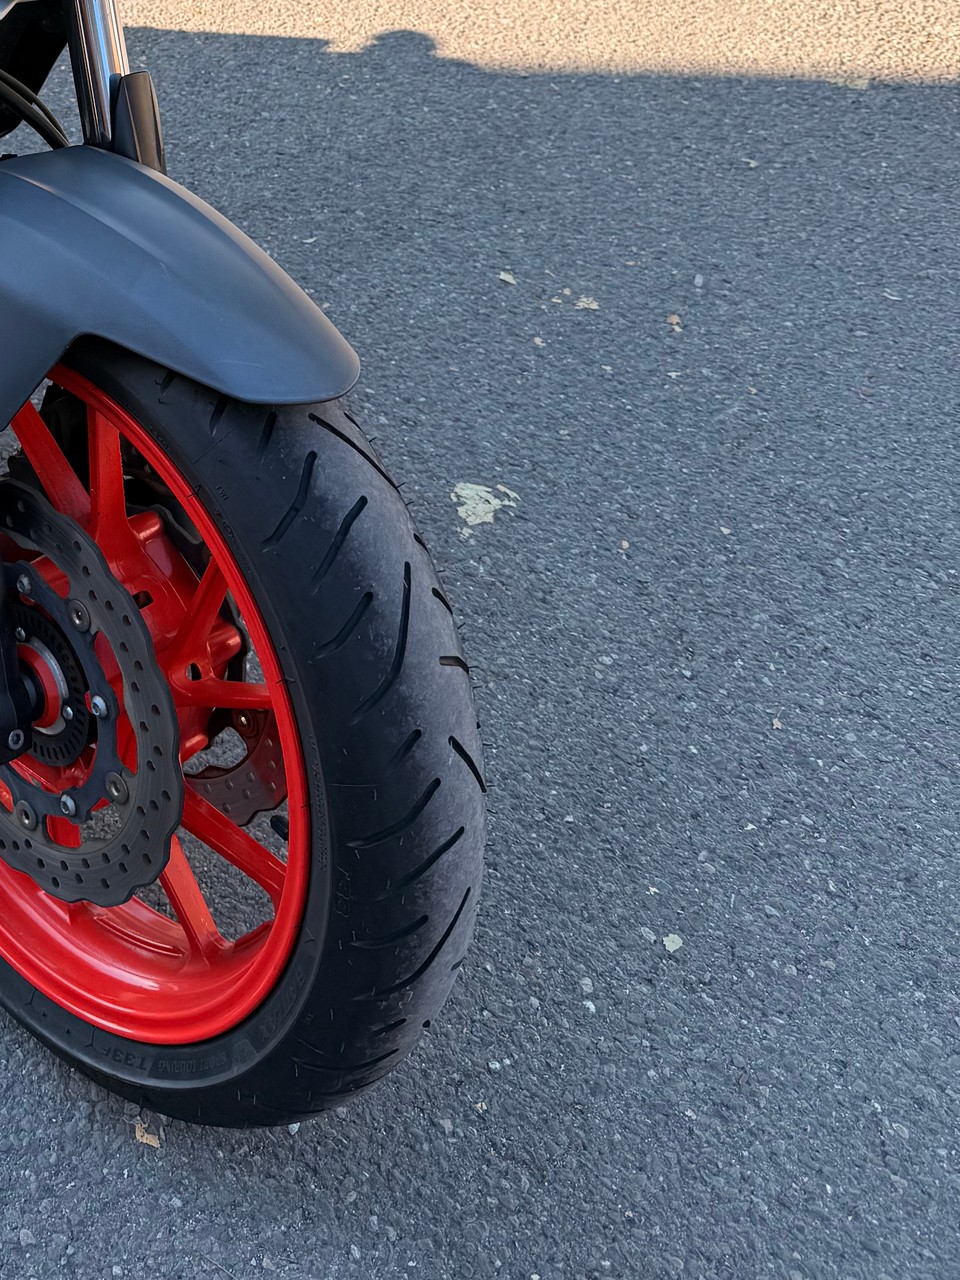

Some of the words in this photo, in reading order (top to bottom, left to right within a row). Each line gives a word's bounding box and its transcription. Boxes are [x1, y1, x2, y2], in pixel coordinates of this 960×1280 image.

[101, 1047, 147, 1071] T33F
[158, 1059, 196, 1073] TOURING
[199, 1051, 227, 1072] SPORT
